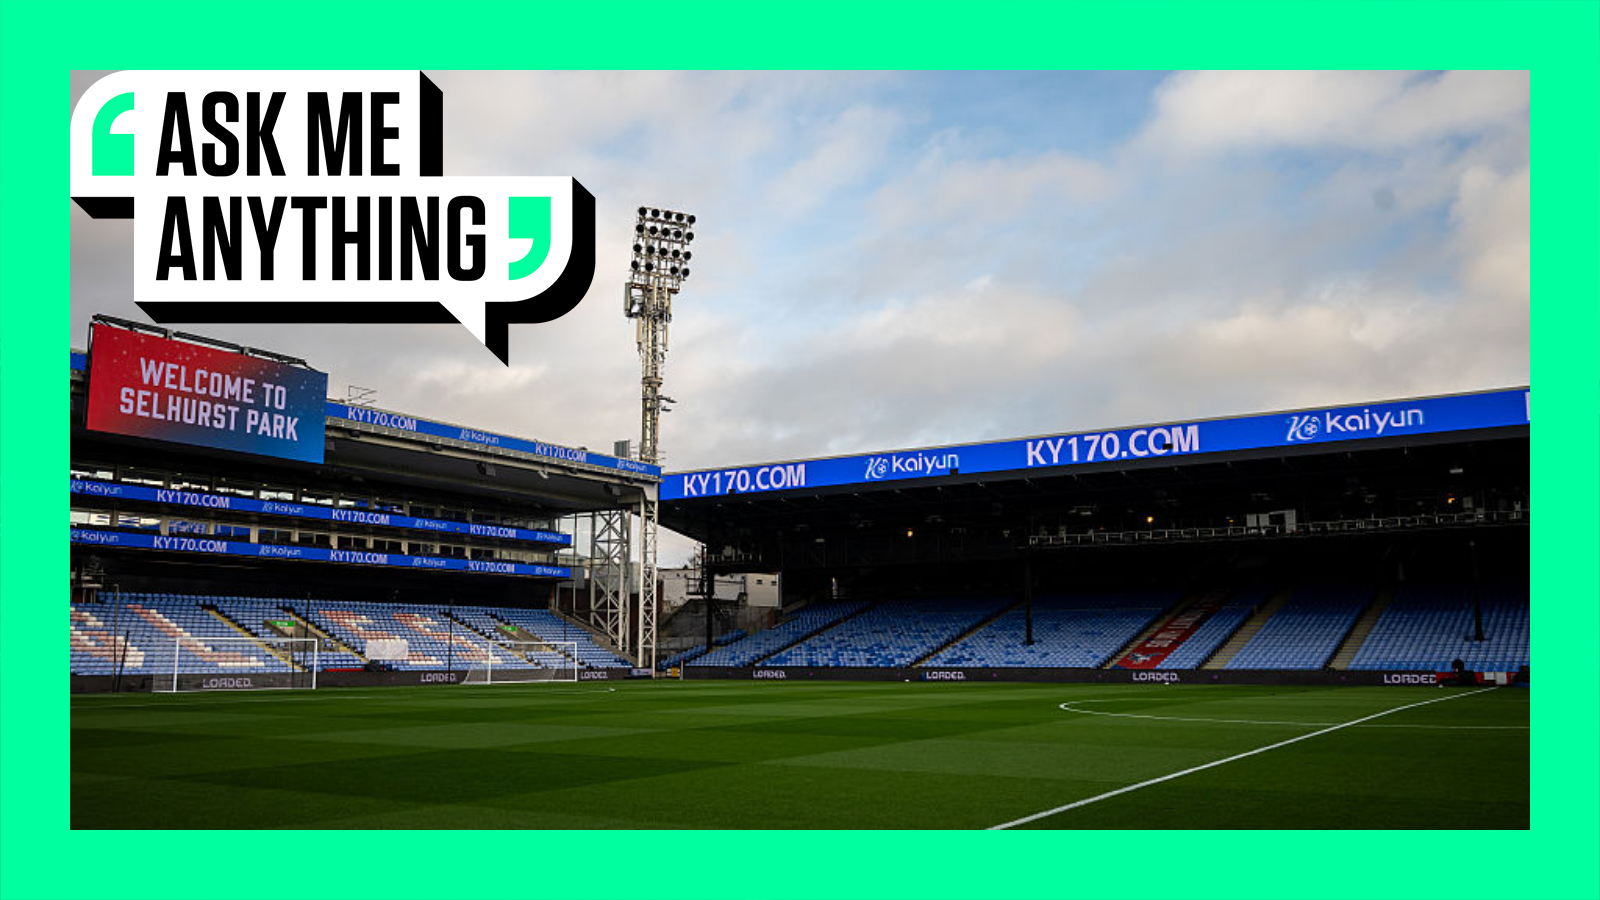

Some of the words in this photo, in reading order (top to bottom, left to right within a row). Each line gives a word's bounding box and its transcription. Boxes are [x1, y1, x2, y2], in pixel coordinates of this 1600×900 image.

[140, 357, 255, 404] WELCOME
[262, 382, 286, 410] TO
[120, 387, 240, 431] SELHURST
[246, 409, 299, 441] PARK
[347, 407, 417, 431] KY170.COM
[535, 443, 587, 463] KY170.COM
[683, 463, 806, 497] KY170.COM
[1026, 424, 1200, 466] KY170.COM
[157, 489, 230, 508] KY170.COM
[332, 509, 390, 525] KY170.COM
[470, 524, 517, 538] KY170.COM
[153, 535, 227, 553] KY170.COM
[330, 550, 388, 565] KY170.COM
